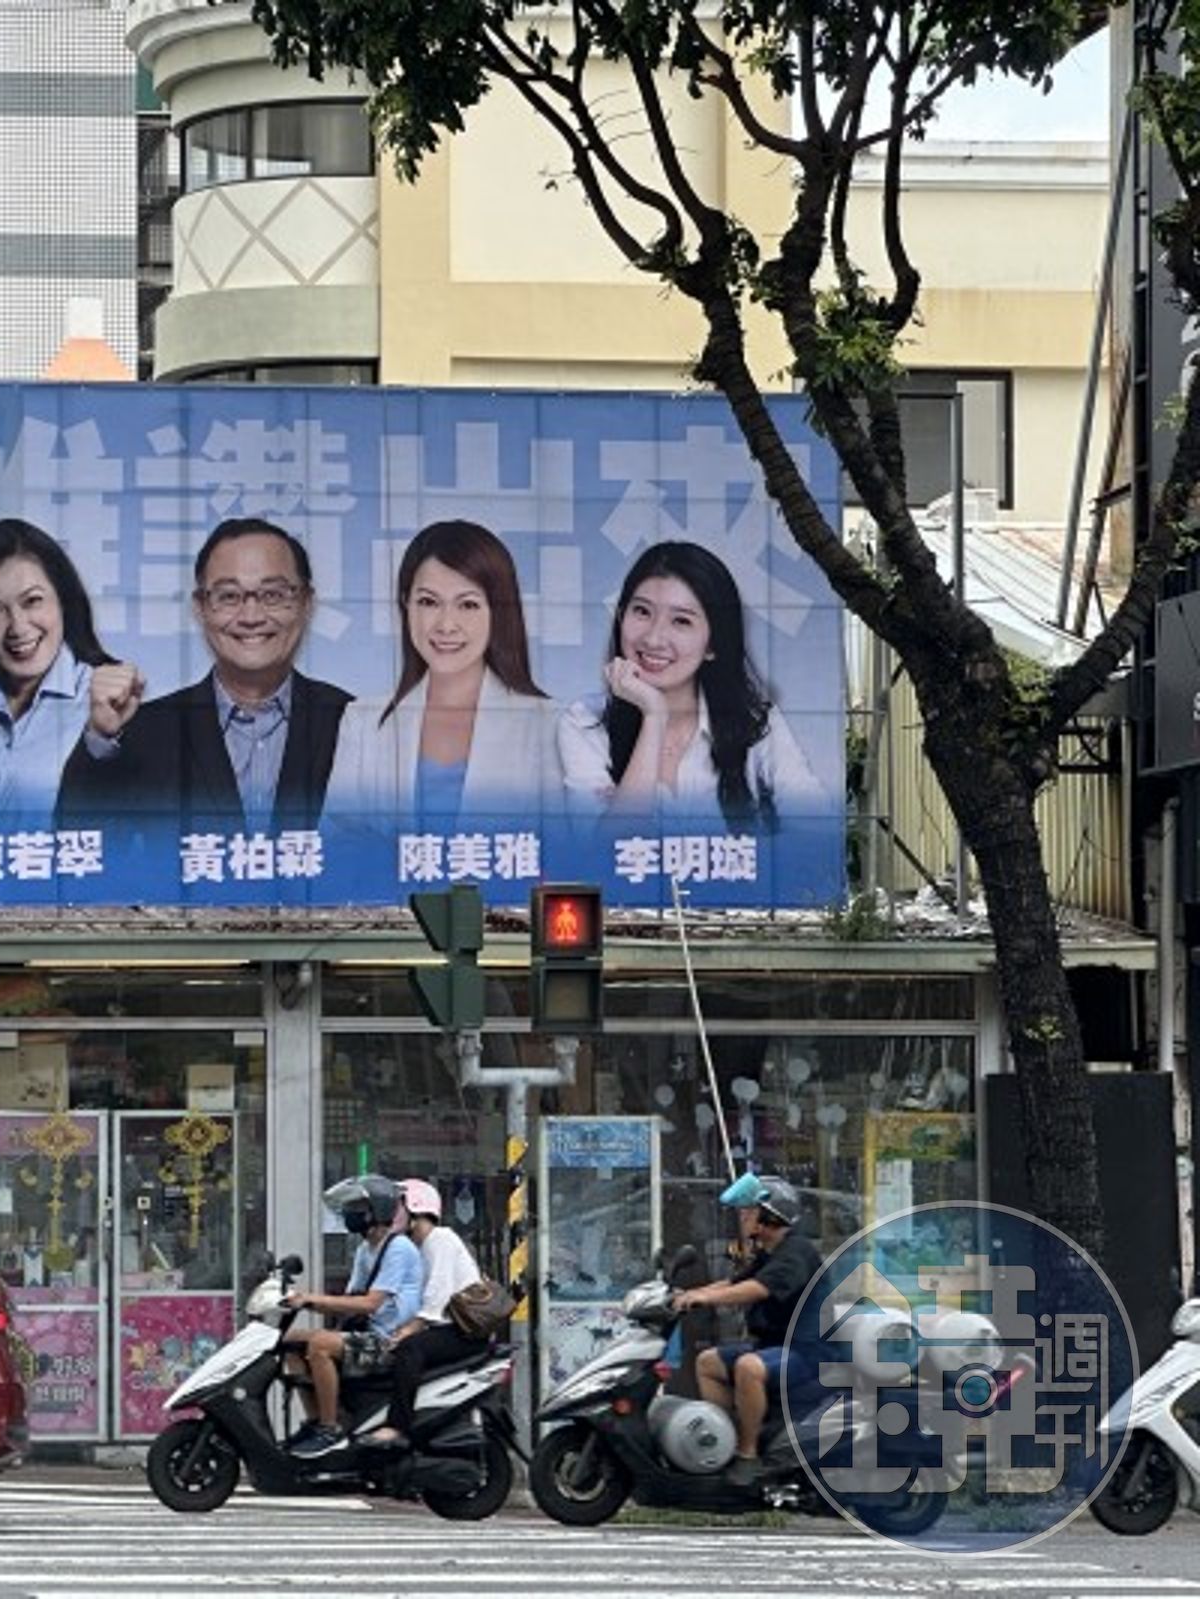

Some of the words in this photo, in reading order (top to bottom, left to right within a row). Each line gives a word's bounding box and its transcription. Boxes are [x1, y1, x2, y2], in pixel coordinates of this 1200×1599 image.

[180, 829, 325, 884] 黃柏霖
[399, 832, 541, 883] 陳美雅
[615, 833, 757, 883] 李明璇
